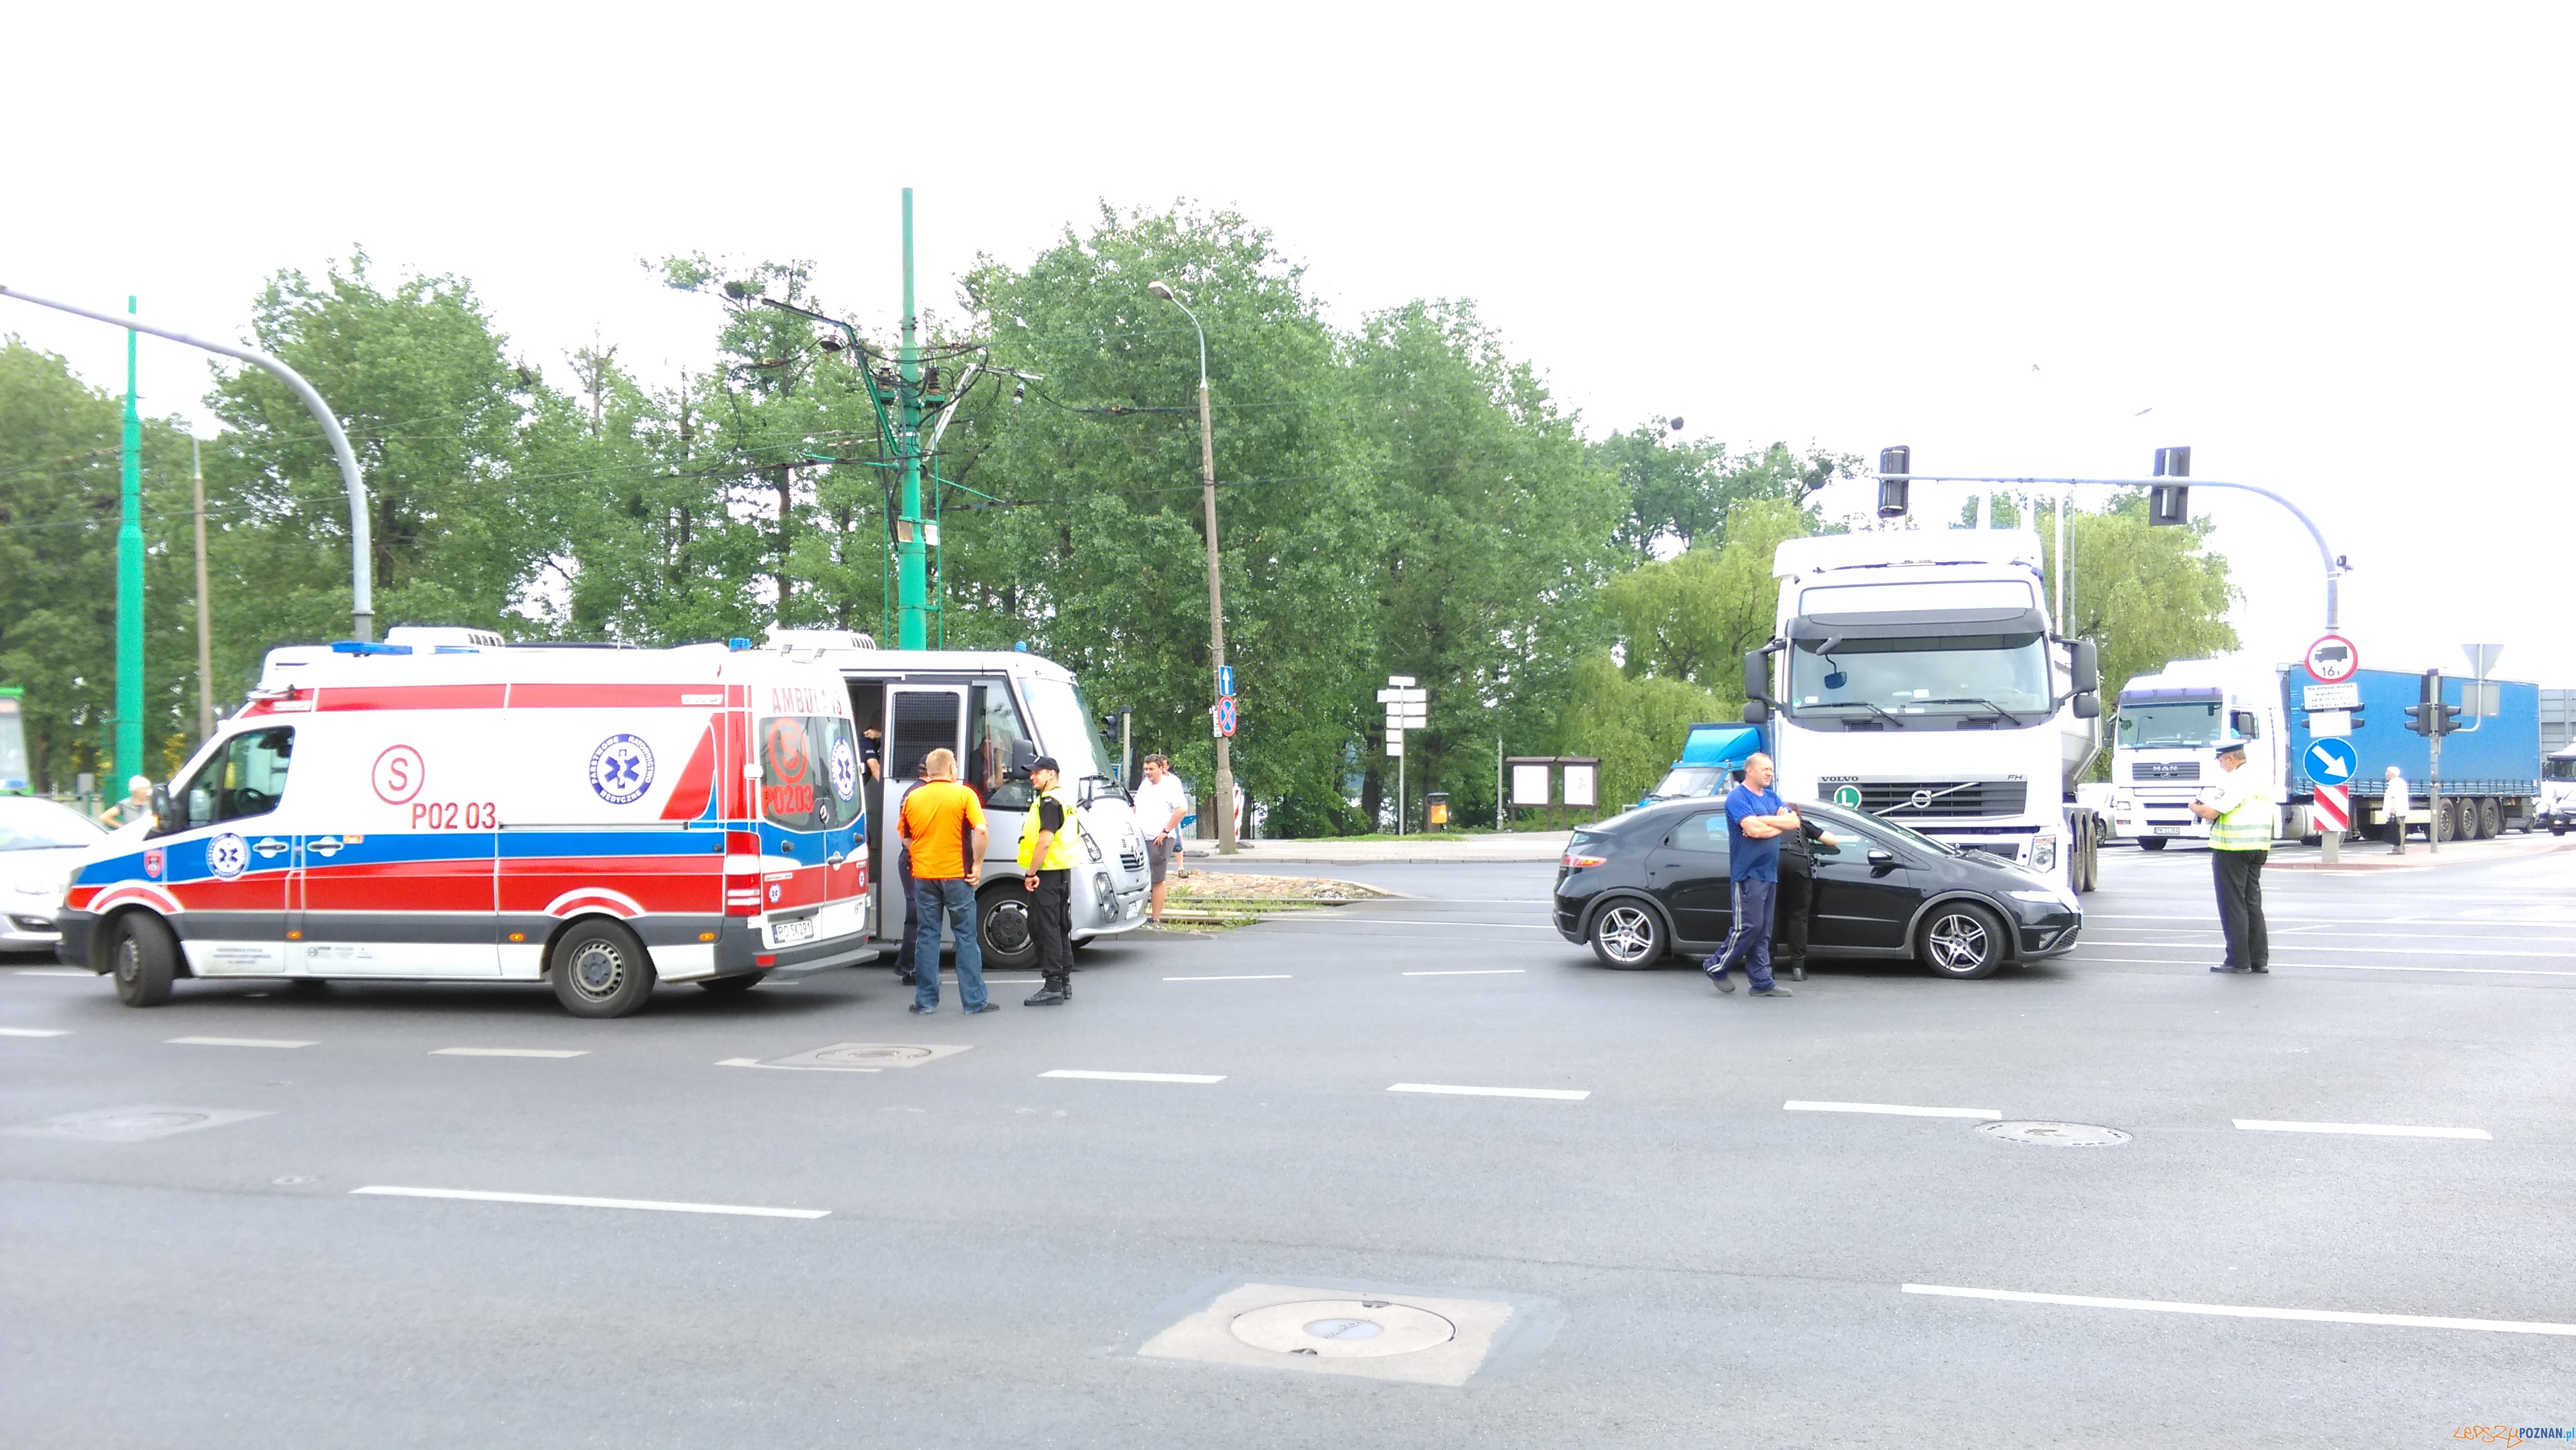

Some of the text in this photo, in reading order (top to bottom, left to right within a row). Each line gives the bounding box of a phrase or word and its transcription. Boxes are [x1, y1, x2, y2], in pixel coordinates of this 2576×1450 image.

[2322, 666, 2335, 677] 16
[779, 731, 799, 769] S
[388, 757, 408, 791] S
[599, 789, 642, 803] MEDYCZNE
[1841, 790, 1854, 806] L
[465, 802, 496, 830] 03
